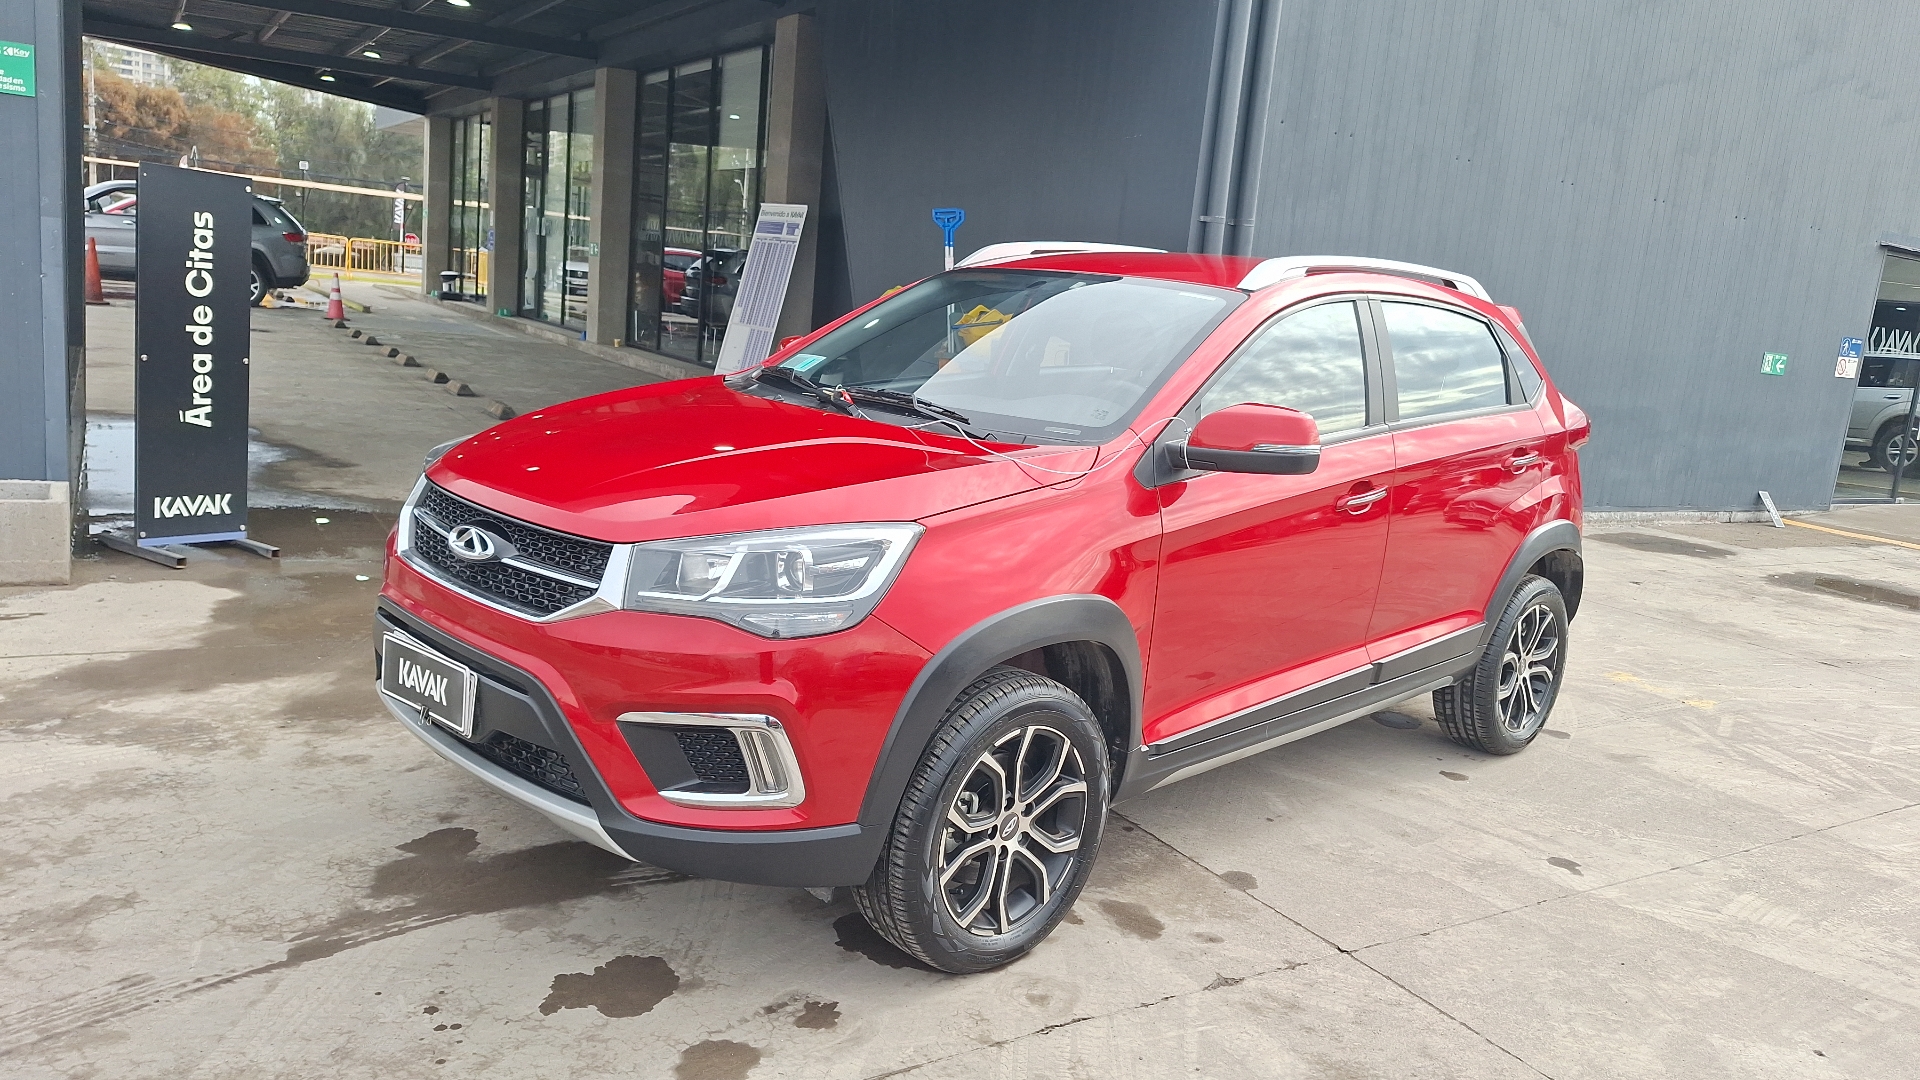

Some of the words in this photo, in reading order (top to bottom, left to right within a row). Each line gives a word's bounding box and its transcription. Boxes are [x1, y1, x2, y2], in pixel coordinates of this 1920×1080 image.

[3, 82, 27, 92] sismo
[185, 211, 214, 298] Citas
[185, 304, 214, 346] de
[178, 353, 213, 428] Área
[154, 493, 232, 519] KAVAK
[398, 657, 448, 707] KAVAK
